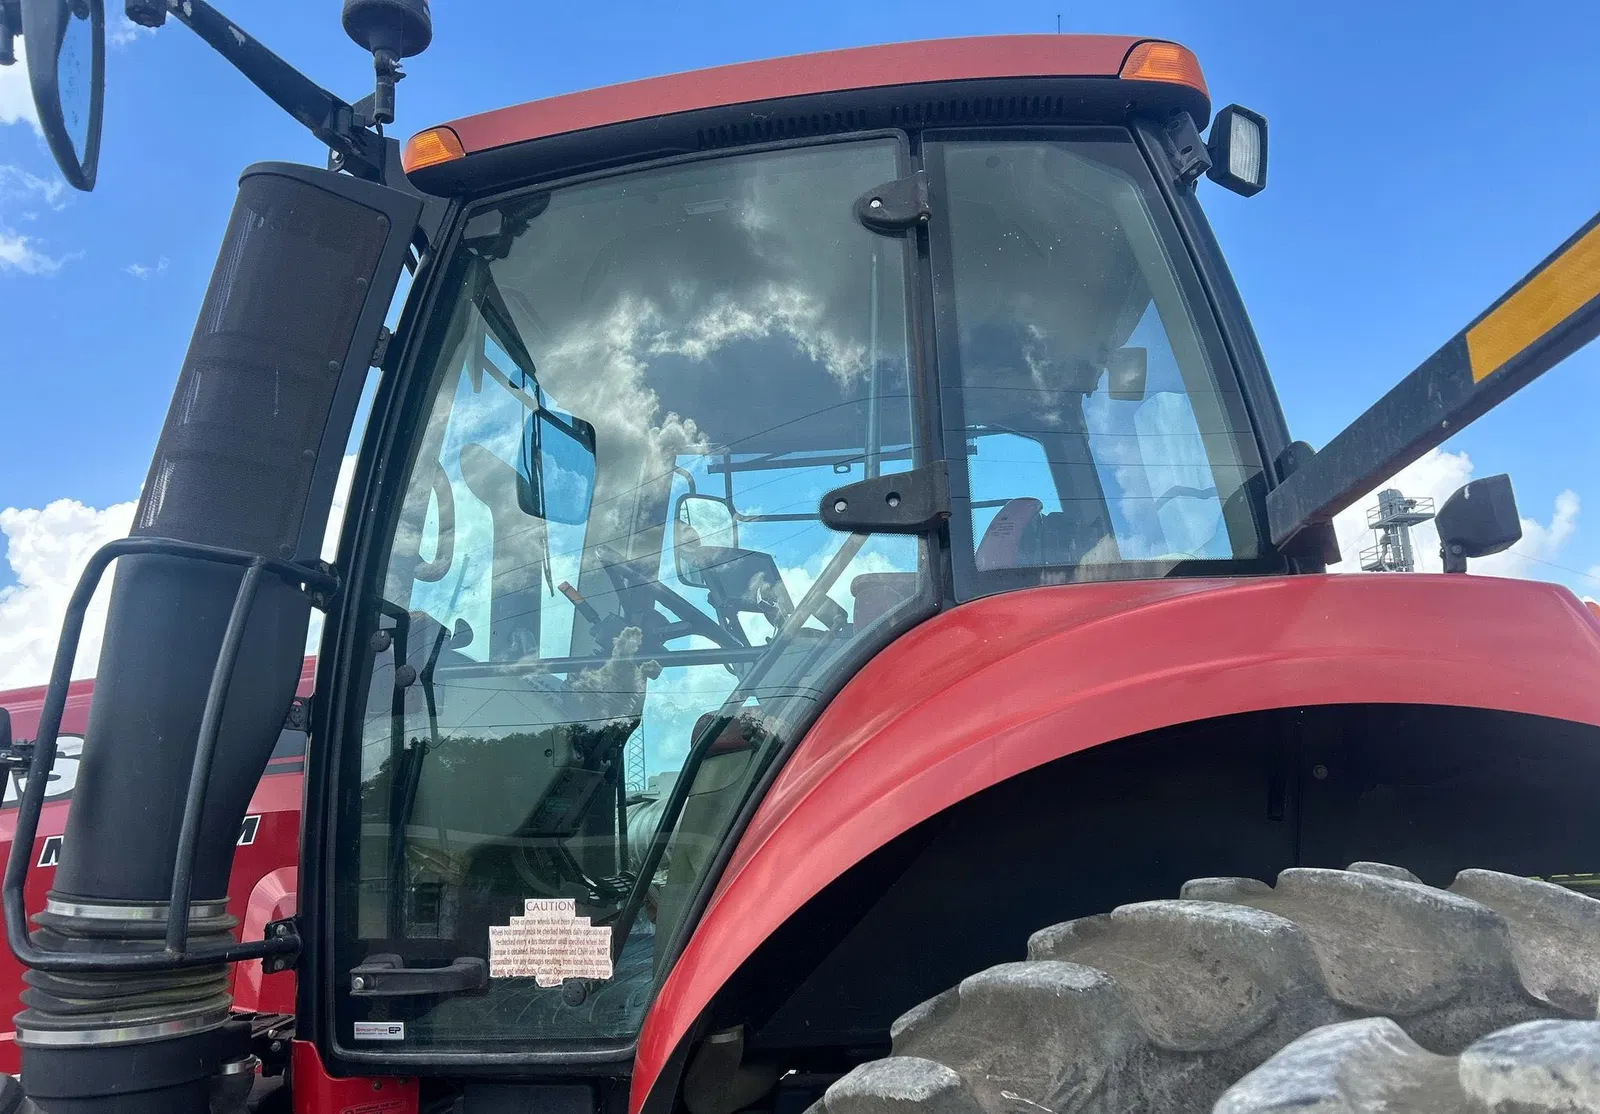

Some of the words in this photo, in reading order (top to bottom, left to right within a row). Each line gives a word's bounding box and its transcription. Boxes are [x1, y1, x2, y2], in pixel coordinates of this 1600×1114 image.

[526, 901, 575, 912] CAUTION
[597, 948, 608, 956] NOT
[388, 1026, 401, 1034] EP
